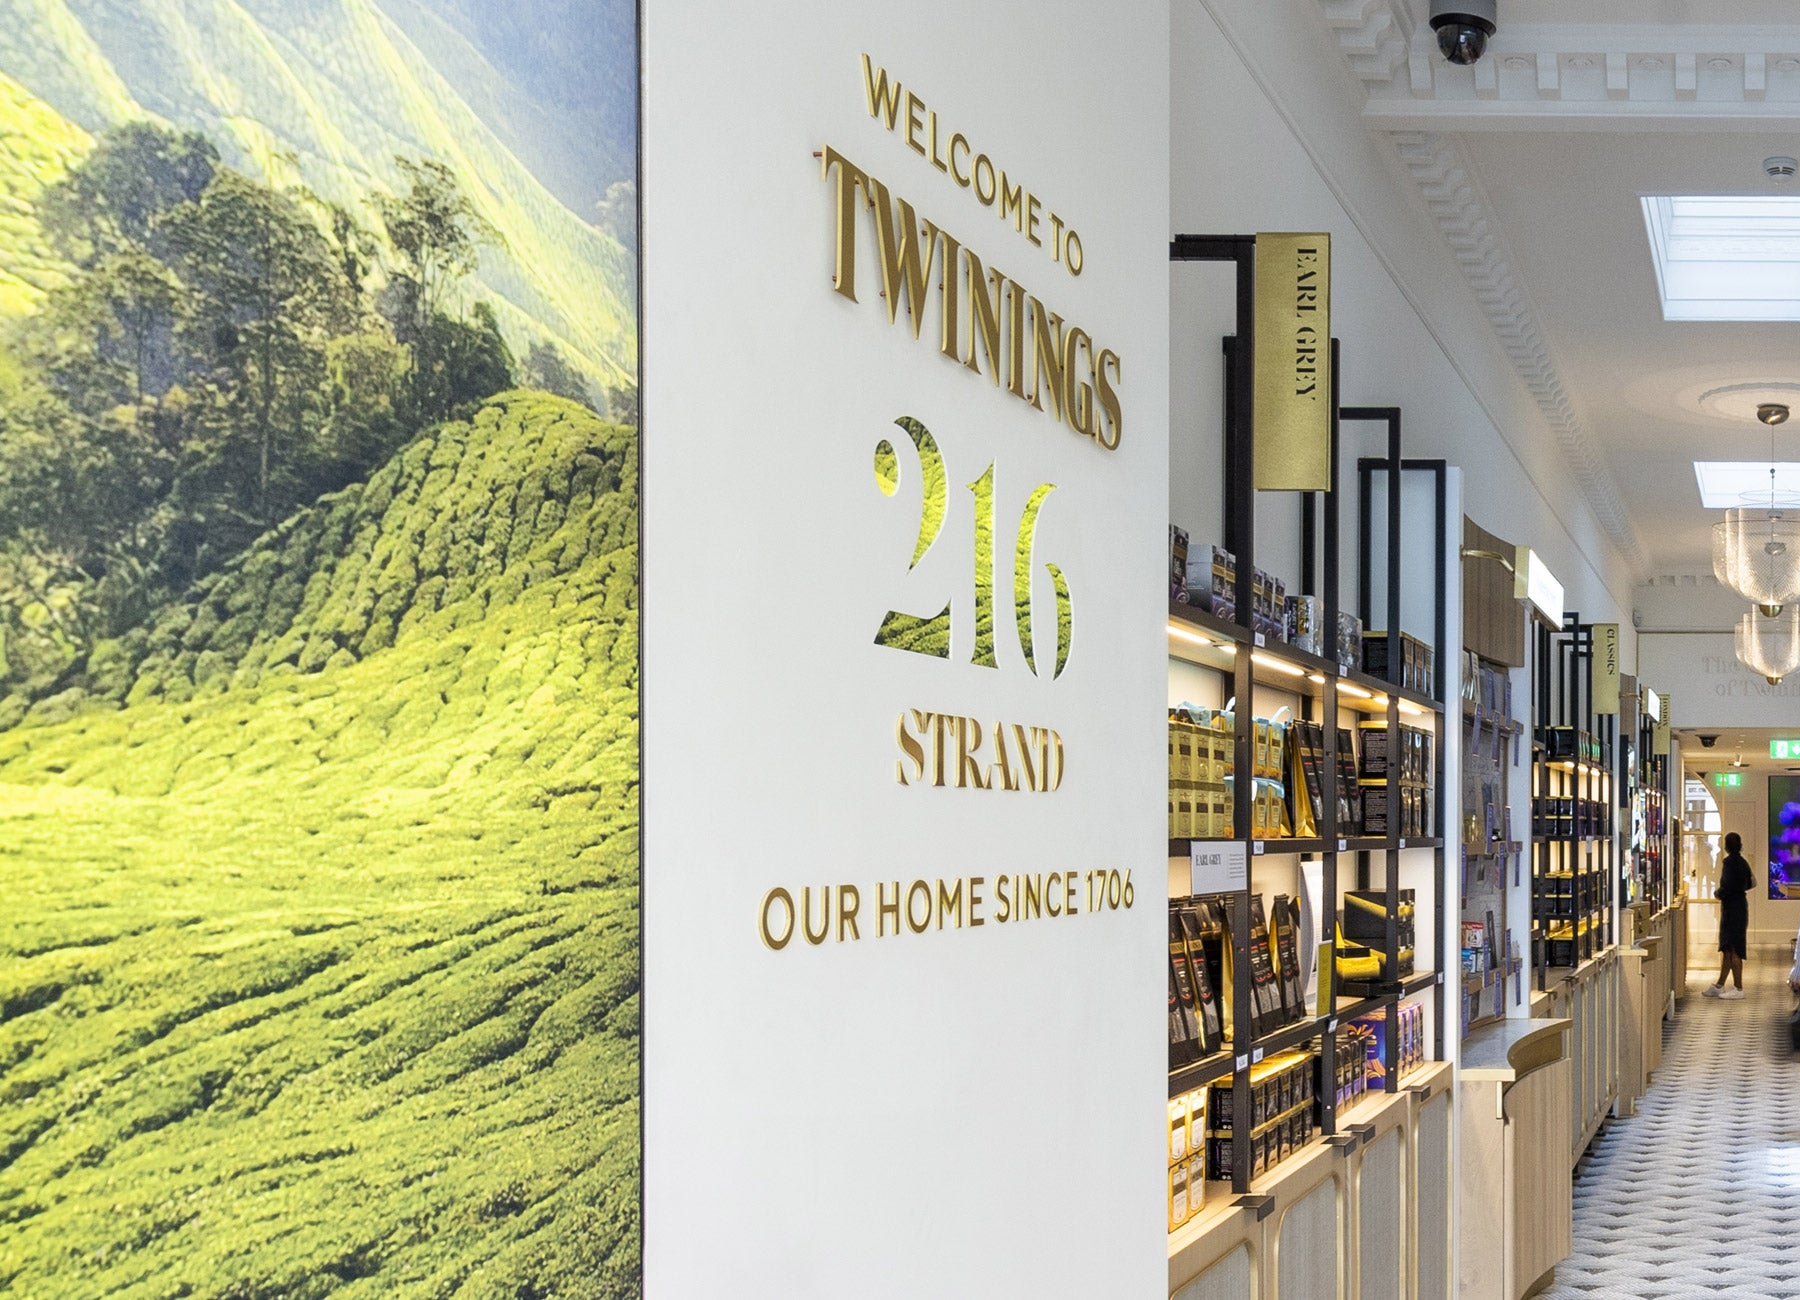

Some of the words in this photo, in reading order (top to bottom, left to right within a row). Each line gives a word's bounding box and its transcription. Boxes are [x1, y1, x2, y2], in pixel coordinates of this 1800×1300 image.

[861, 53, 1042, 248] WELCOME
[1048, 212, 1083, 277] TO
[820, 144, 1122, 452] TWININGS
[1296, 248, 1317, 318] EARL
[1295, 326, 1316, 400] GREY
[874, 416, 1075, 681] 216
[1607, 628, 1615, 675] CLASSICS
[896, 708, 1064, 792] STRAND
[759, 884, 861, 951] OUR
[875, 877, 985, 938] HOME
[993, 871, 1078, 923] SINCE
[1085, 868, 1135, 914] 1706
